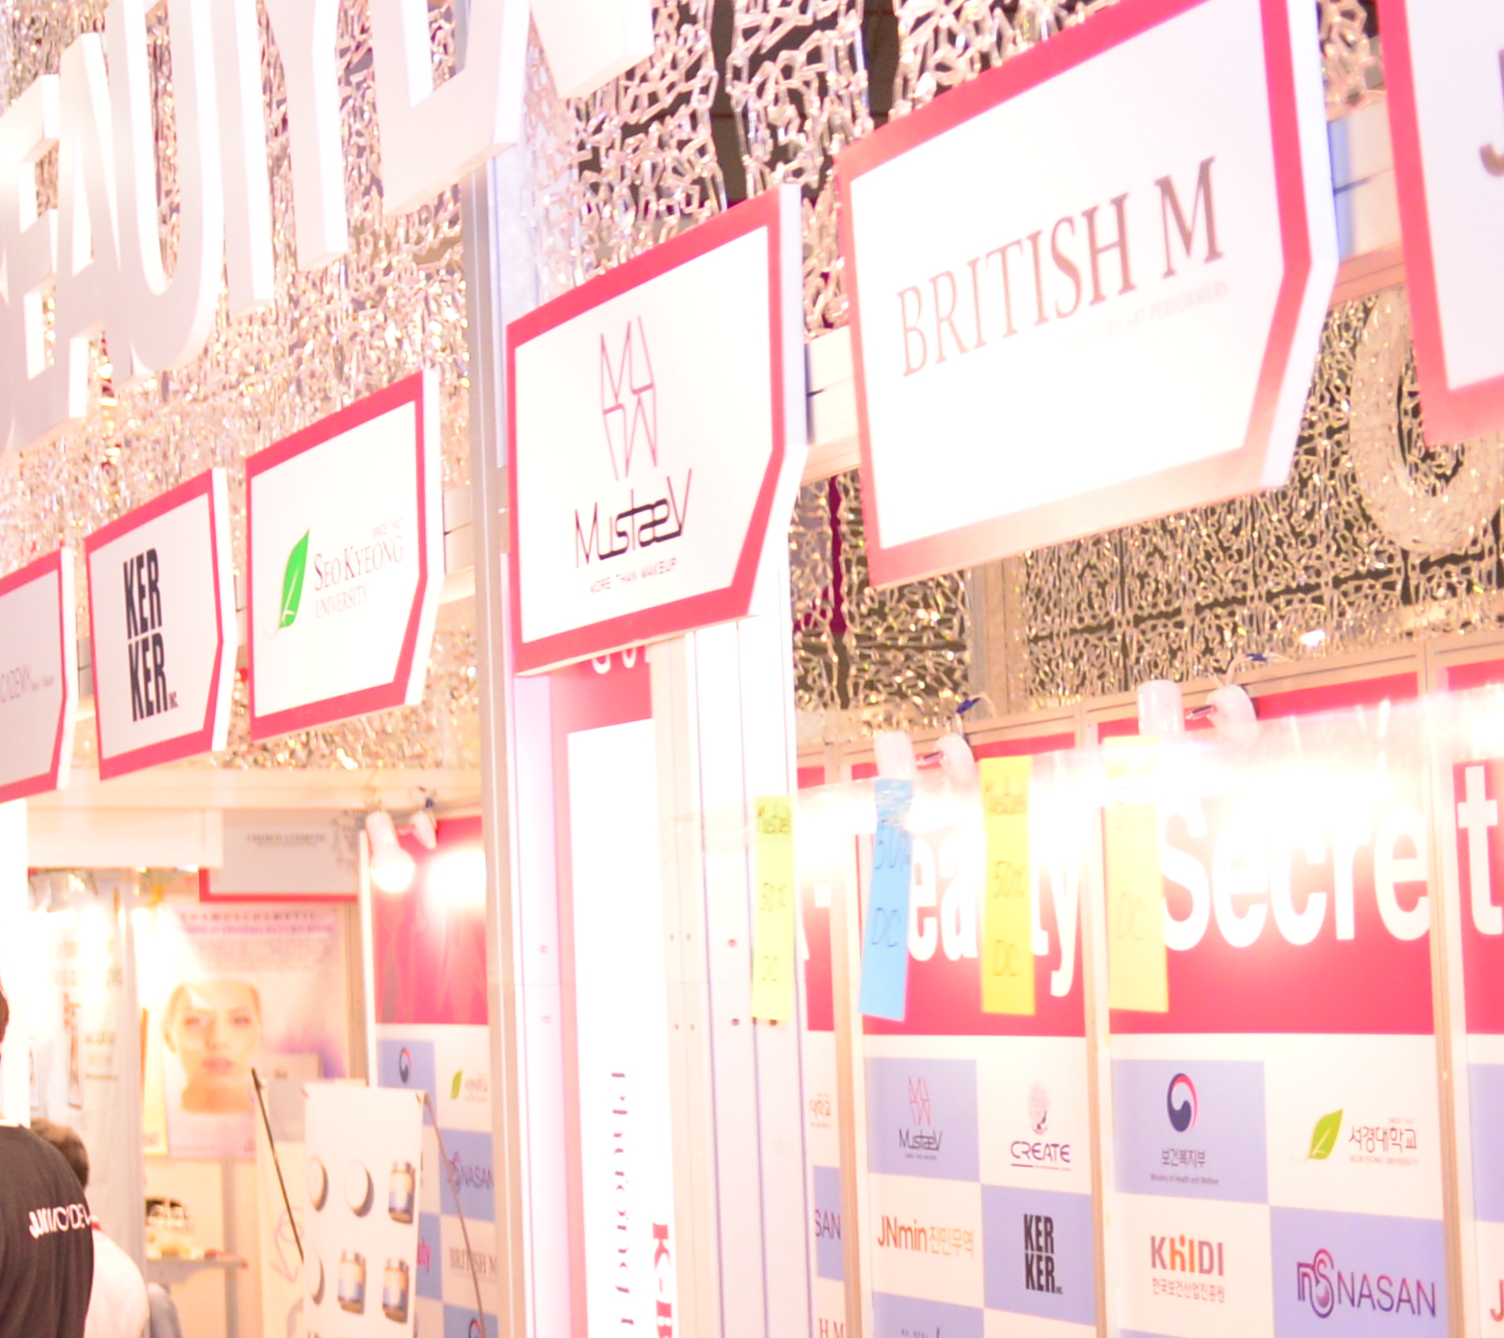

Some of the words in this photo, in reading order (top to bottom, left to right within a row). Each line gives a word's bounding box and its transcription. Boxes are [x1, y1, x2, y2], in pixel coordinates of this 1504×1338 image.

[897, 190, 1136, 377] BRITISH
[1159, 157, 1223, 277] M
[123, 547, 162, 640] KER
[128, 632, 170, 722] KER
[1010, 1141, 1071, 1163] CREATE
[1349, 1125, 1418, 1154] 서경대학교
[877, 1214, 927, 1252] JNmin
[1023, 1213, 1055, 1254] KER
[1025, 1254, 1056, 1294] KER
[1337, 1270, 1436, 1318] NASAN
